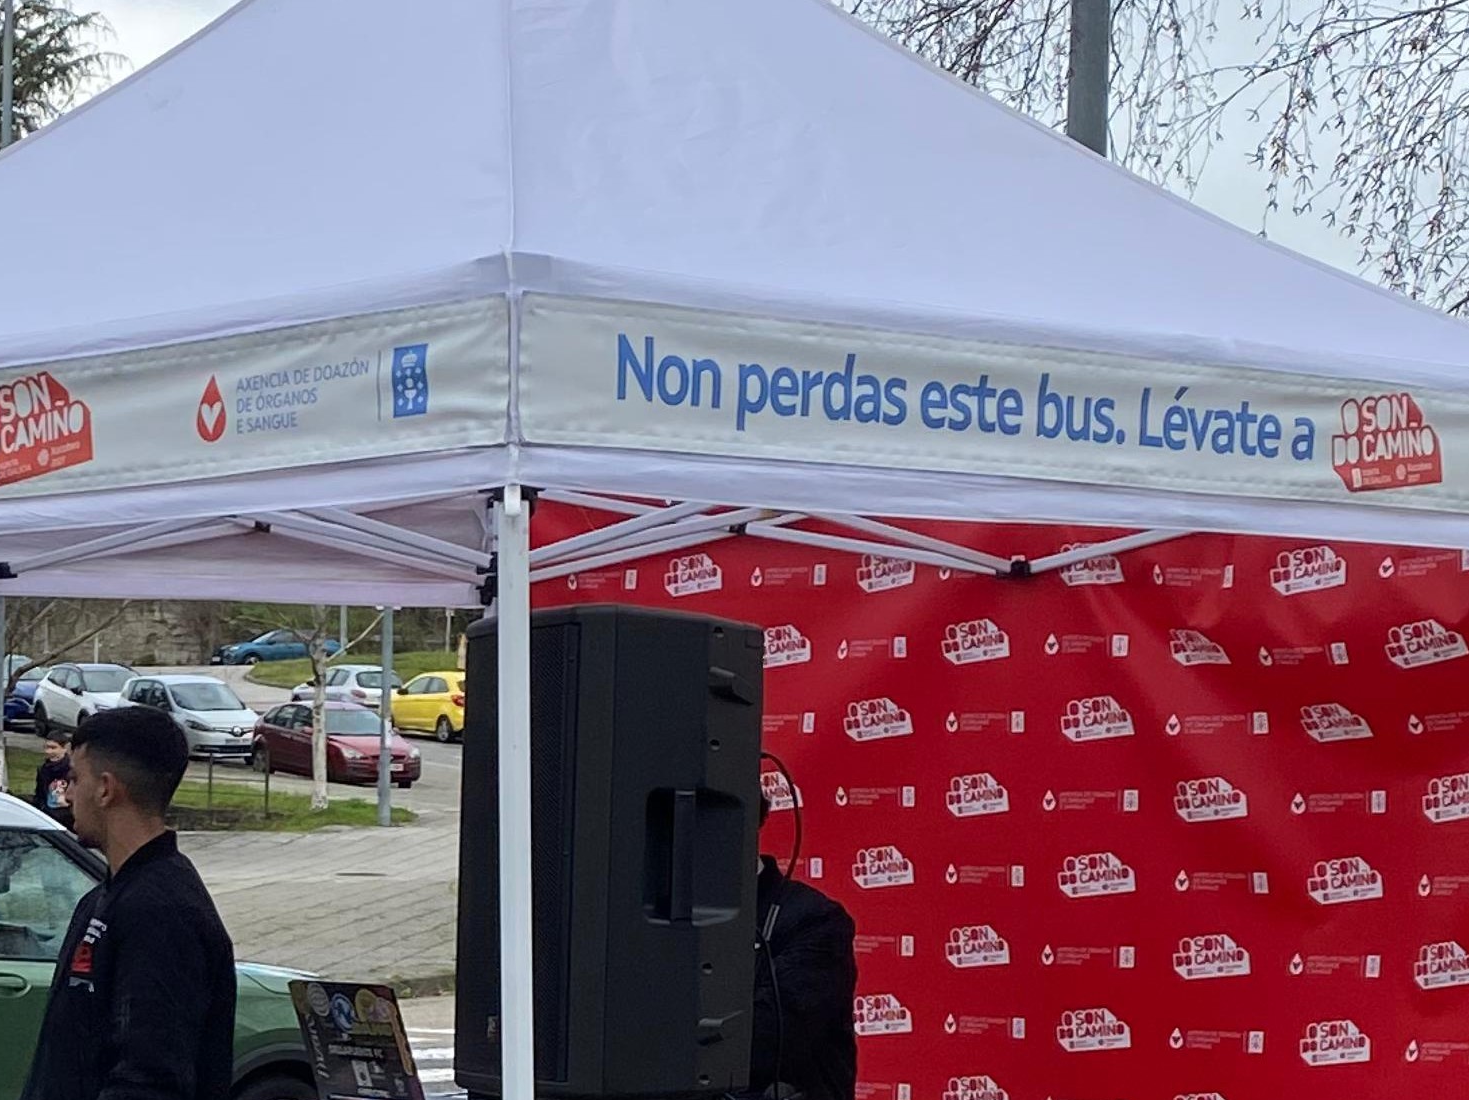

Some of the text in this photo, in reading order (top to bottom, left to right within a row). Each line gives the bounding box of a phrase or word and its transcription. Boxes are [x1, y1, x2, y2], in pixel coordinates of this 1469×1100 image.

[236, 360, 370, 394] AXENCIA DE DOAZÓN
[616, 331, 1317, 461] Non perdas este bus. Lévate a
[236, 388, 318, 414] DE ÓRGANOS
[1342, 394, 1409, 435] O SON
[1, 400, 85, 454] CAMIÑO
[236, 412, 298, 435] E SANGUE
[1333, 421, 1435, 466] DO CAMIÑO
